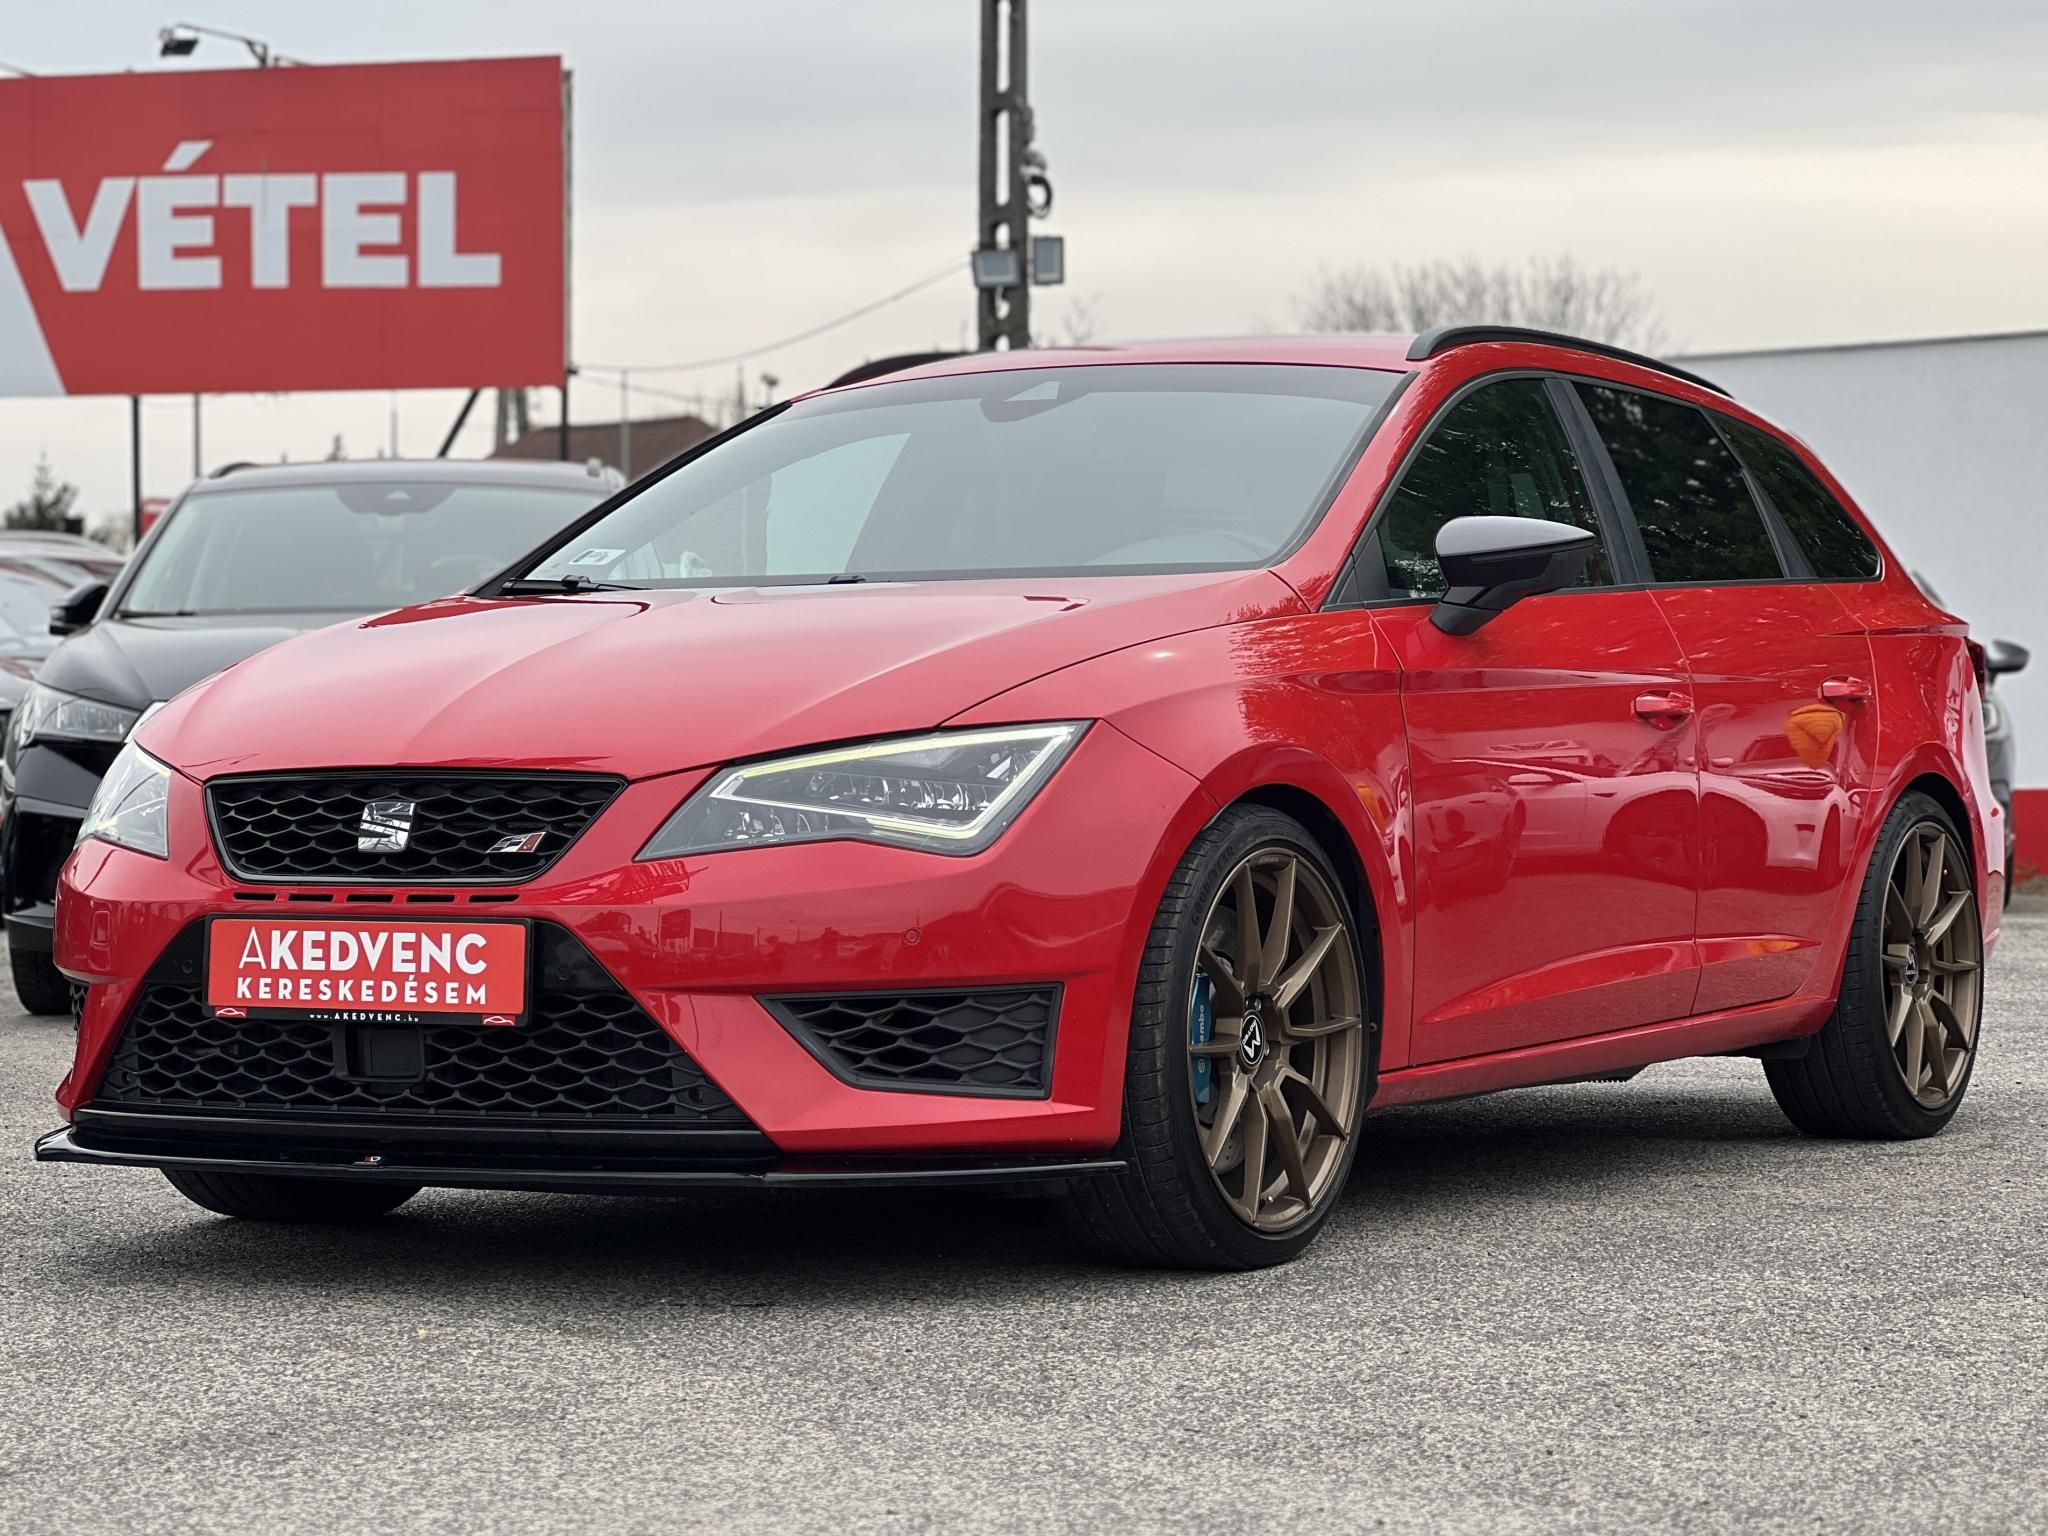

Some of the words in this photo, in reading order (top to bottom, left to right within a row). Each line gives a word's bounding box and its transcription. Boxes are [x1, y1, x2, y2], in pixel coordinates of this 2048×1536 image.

[23, 140, 502, 292] VÉTEL
[236, 974, 487, 1005] KERESKEDÉSEM
[309, 1011, 419, 1022] www.AKEDVENC.hu
